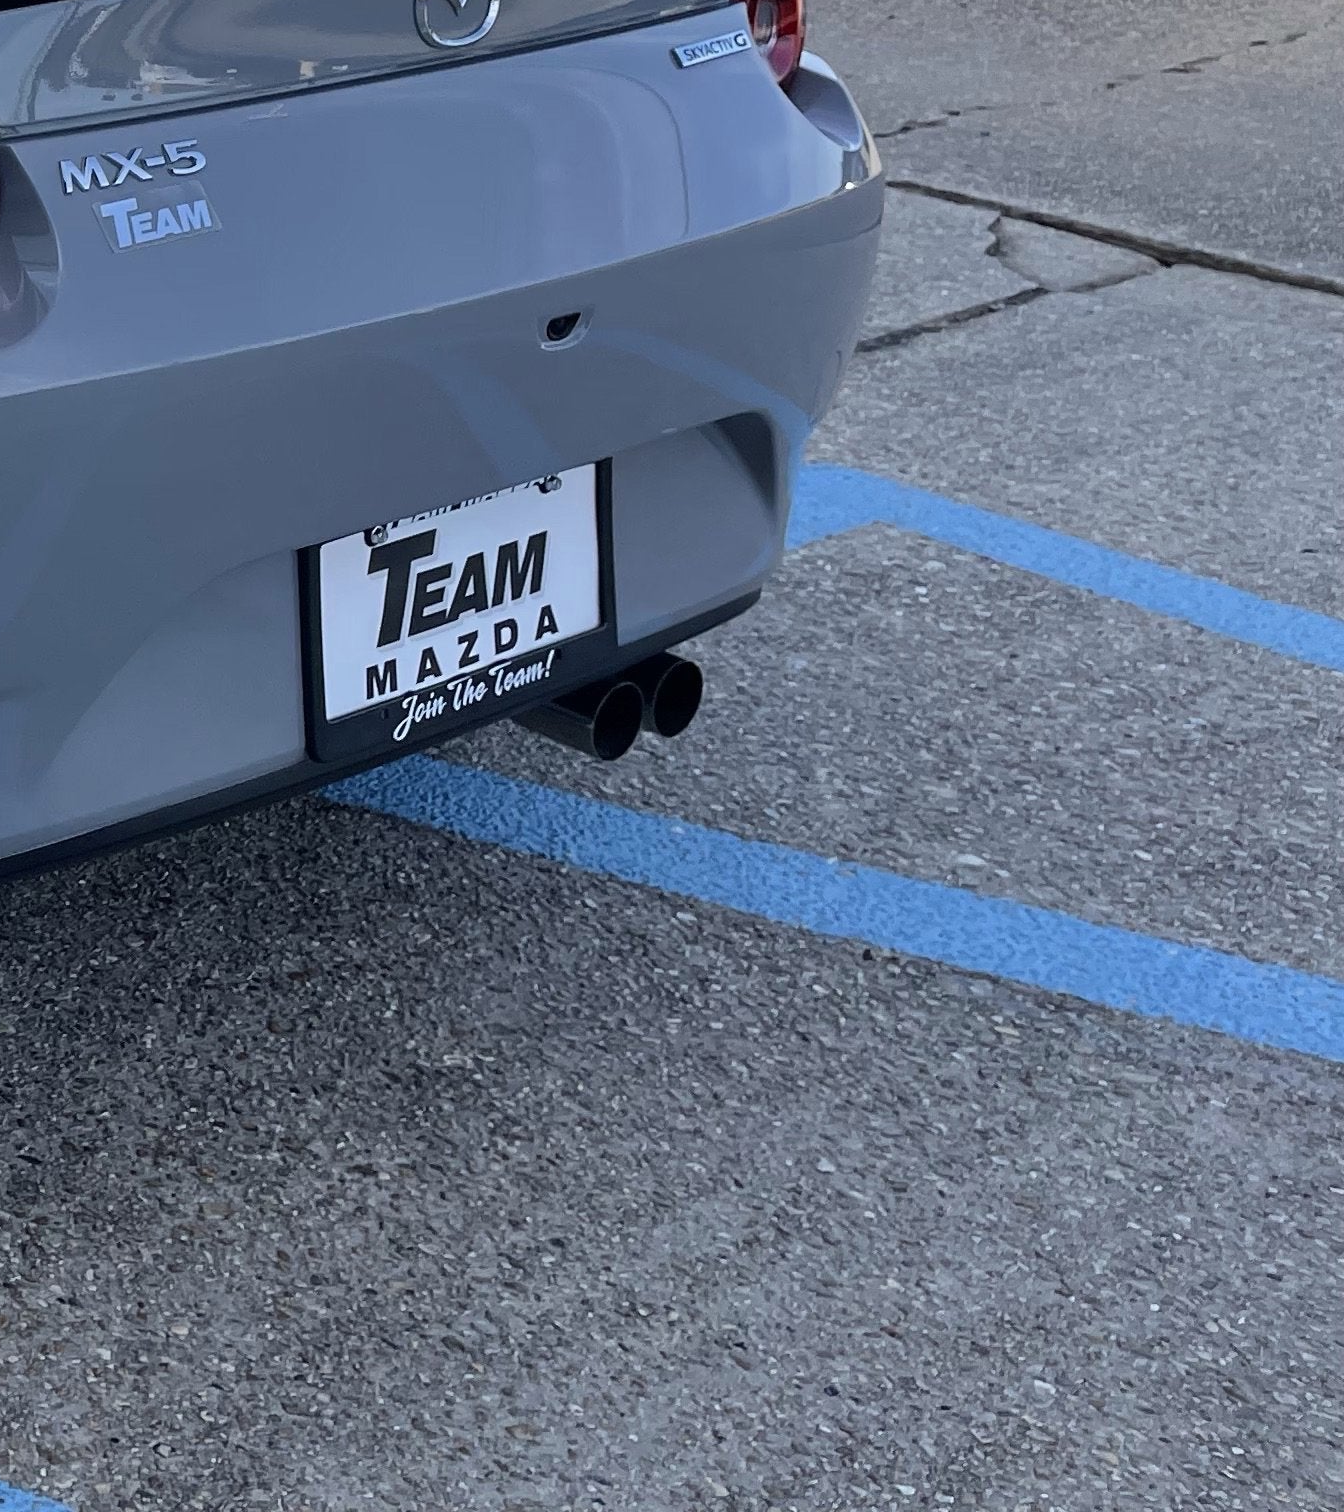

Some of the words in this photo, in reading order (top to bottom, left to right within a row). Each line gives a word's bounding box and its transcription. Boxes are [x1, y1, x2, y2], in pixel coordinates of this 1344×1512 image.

[733, 32, 747, 47] G
[59, 138, 206, 195] MX-5
[100, 197, 212, 249] TEAM
[367, 528, 548, 649] TEAM
[365, 604, 559, 700] MAZDA
[393, 692, 447, 742] Join
[446, 676, 489, 711] The
[488, 649, 555, 697] Team!
